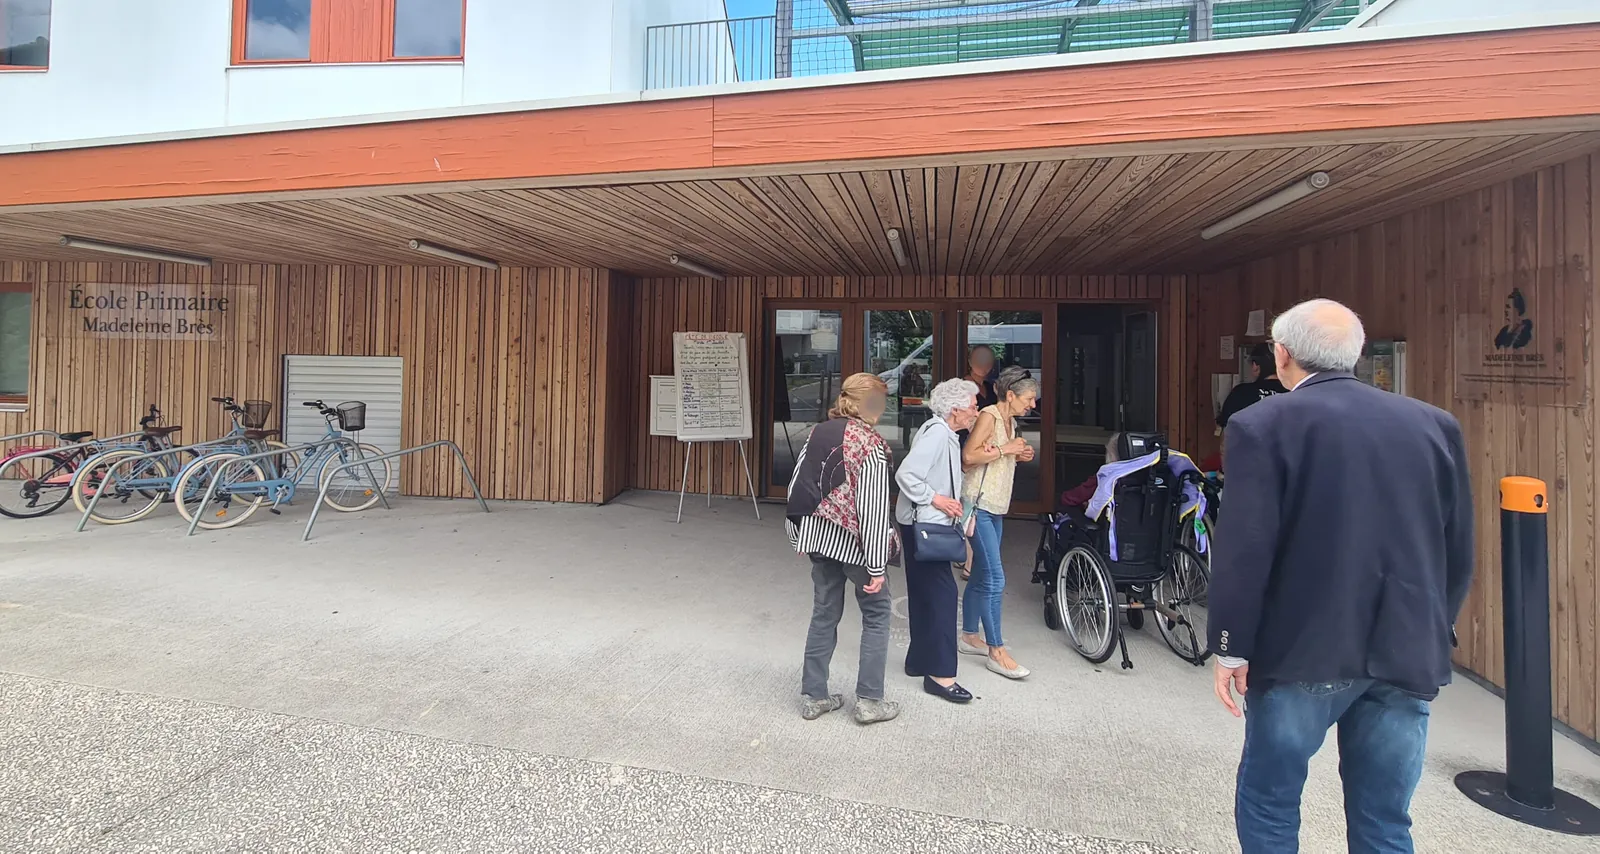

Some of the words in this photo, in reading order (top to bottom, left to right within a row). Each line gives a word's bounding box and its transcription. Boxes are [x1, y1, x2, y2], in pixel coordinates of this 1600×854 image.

[69, 284, 127, 310] École
[136, 290, 229, 311] Primaire
[83, 317, 171, 333] Madeleine
[177, 318, 213, 334] Brès
